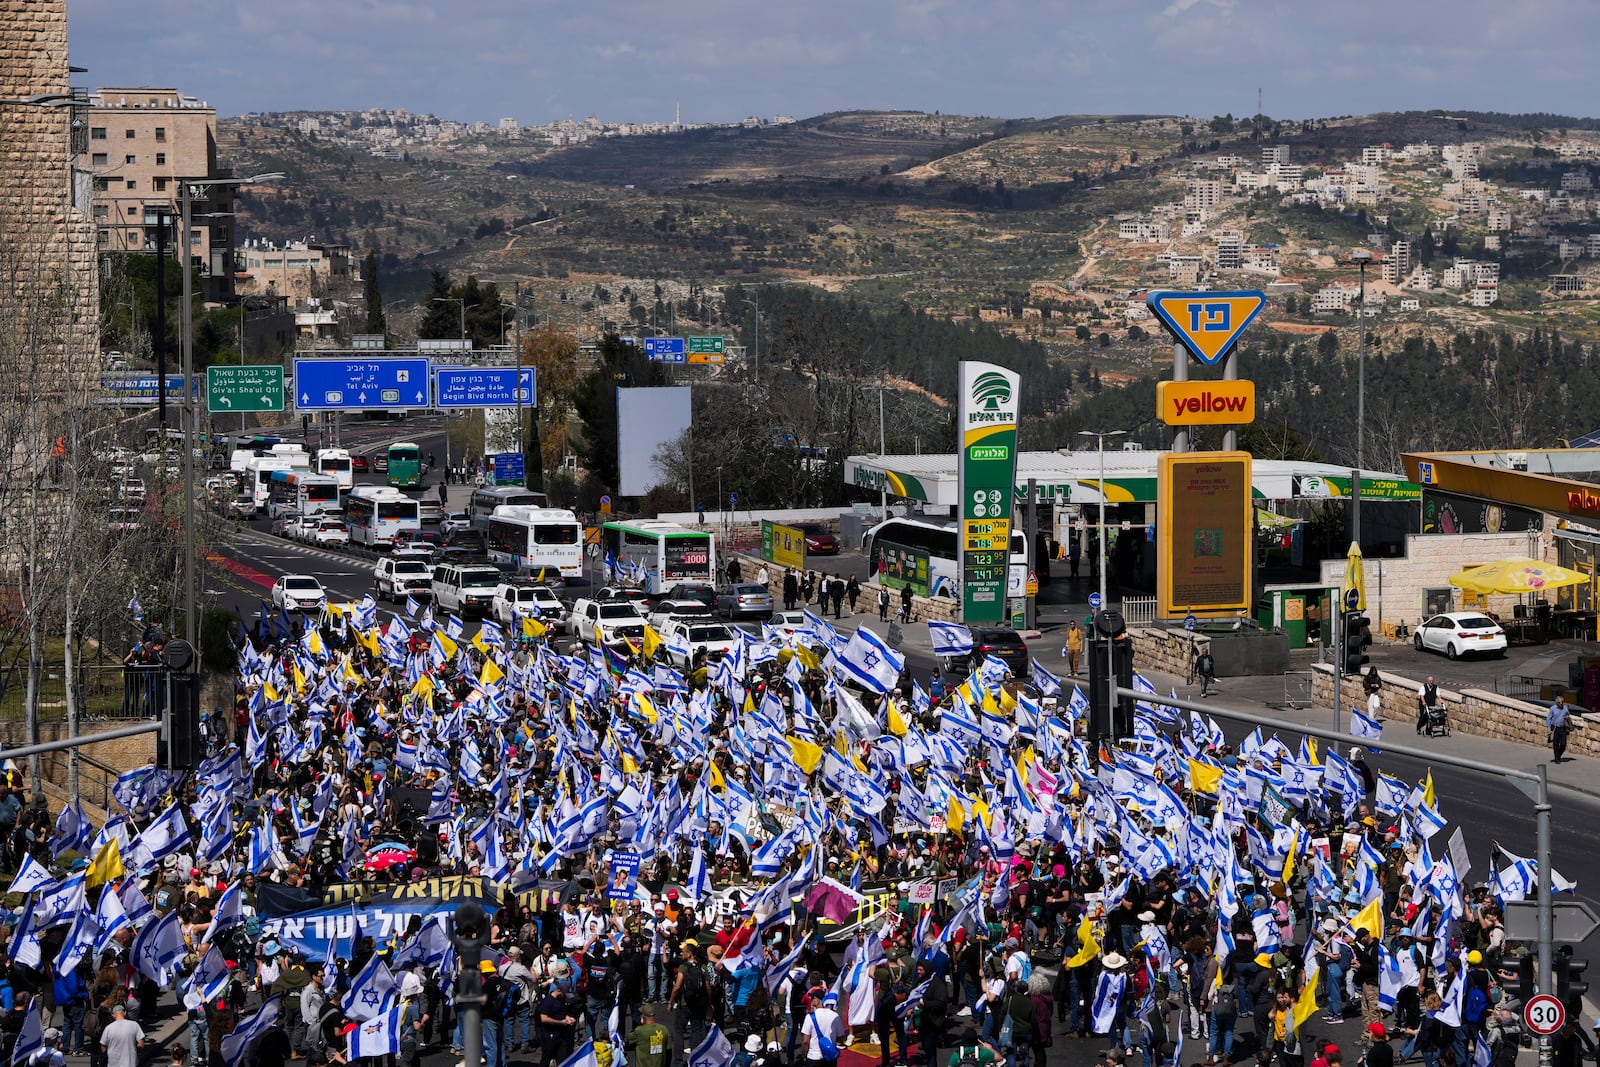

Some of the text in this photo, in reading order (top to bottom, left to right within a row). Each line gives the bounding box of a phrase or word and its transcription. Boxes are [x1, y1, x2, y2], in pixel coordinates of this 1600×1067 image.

[1187, 303, 1231, 332] פז
[214, 369, 234, 377] שאול
[451, 376, 466, 384] צפון
[1172, 392, 1247, 416] yellow
[969, 412, 1014, 424] דור אלון
[974, 448, 1004, 458] אלונית
[854, 465, 870, 483] אלון
[1195, 465, 1222, 475] yellow
[1418, 462, 1432, 484] פז
[1035, 484, 1070, 498] דור
[1343, 488, 1385, 496] אוטובים
[992, 520, 1006, 528] סולר
[992, 535, 1006, 543] סולר
[687, 554, 706, 564] 1000
[994, 552, 1004, 560] 95
[994, 568, 1004, 576] 95
[776, 812, 794, 829] THE
[1533, 1006, 1557, 1024] 30
